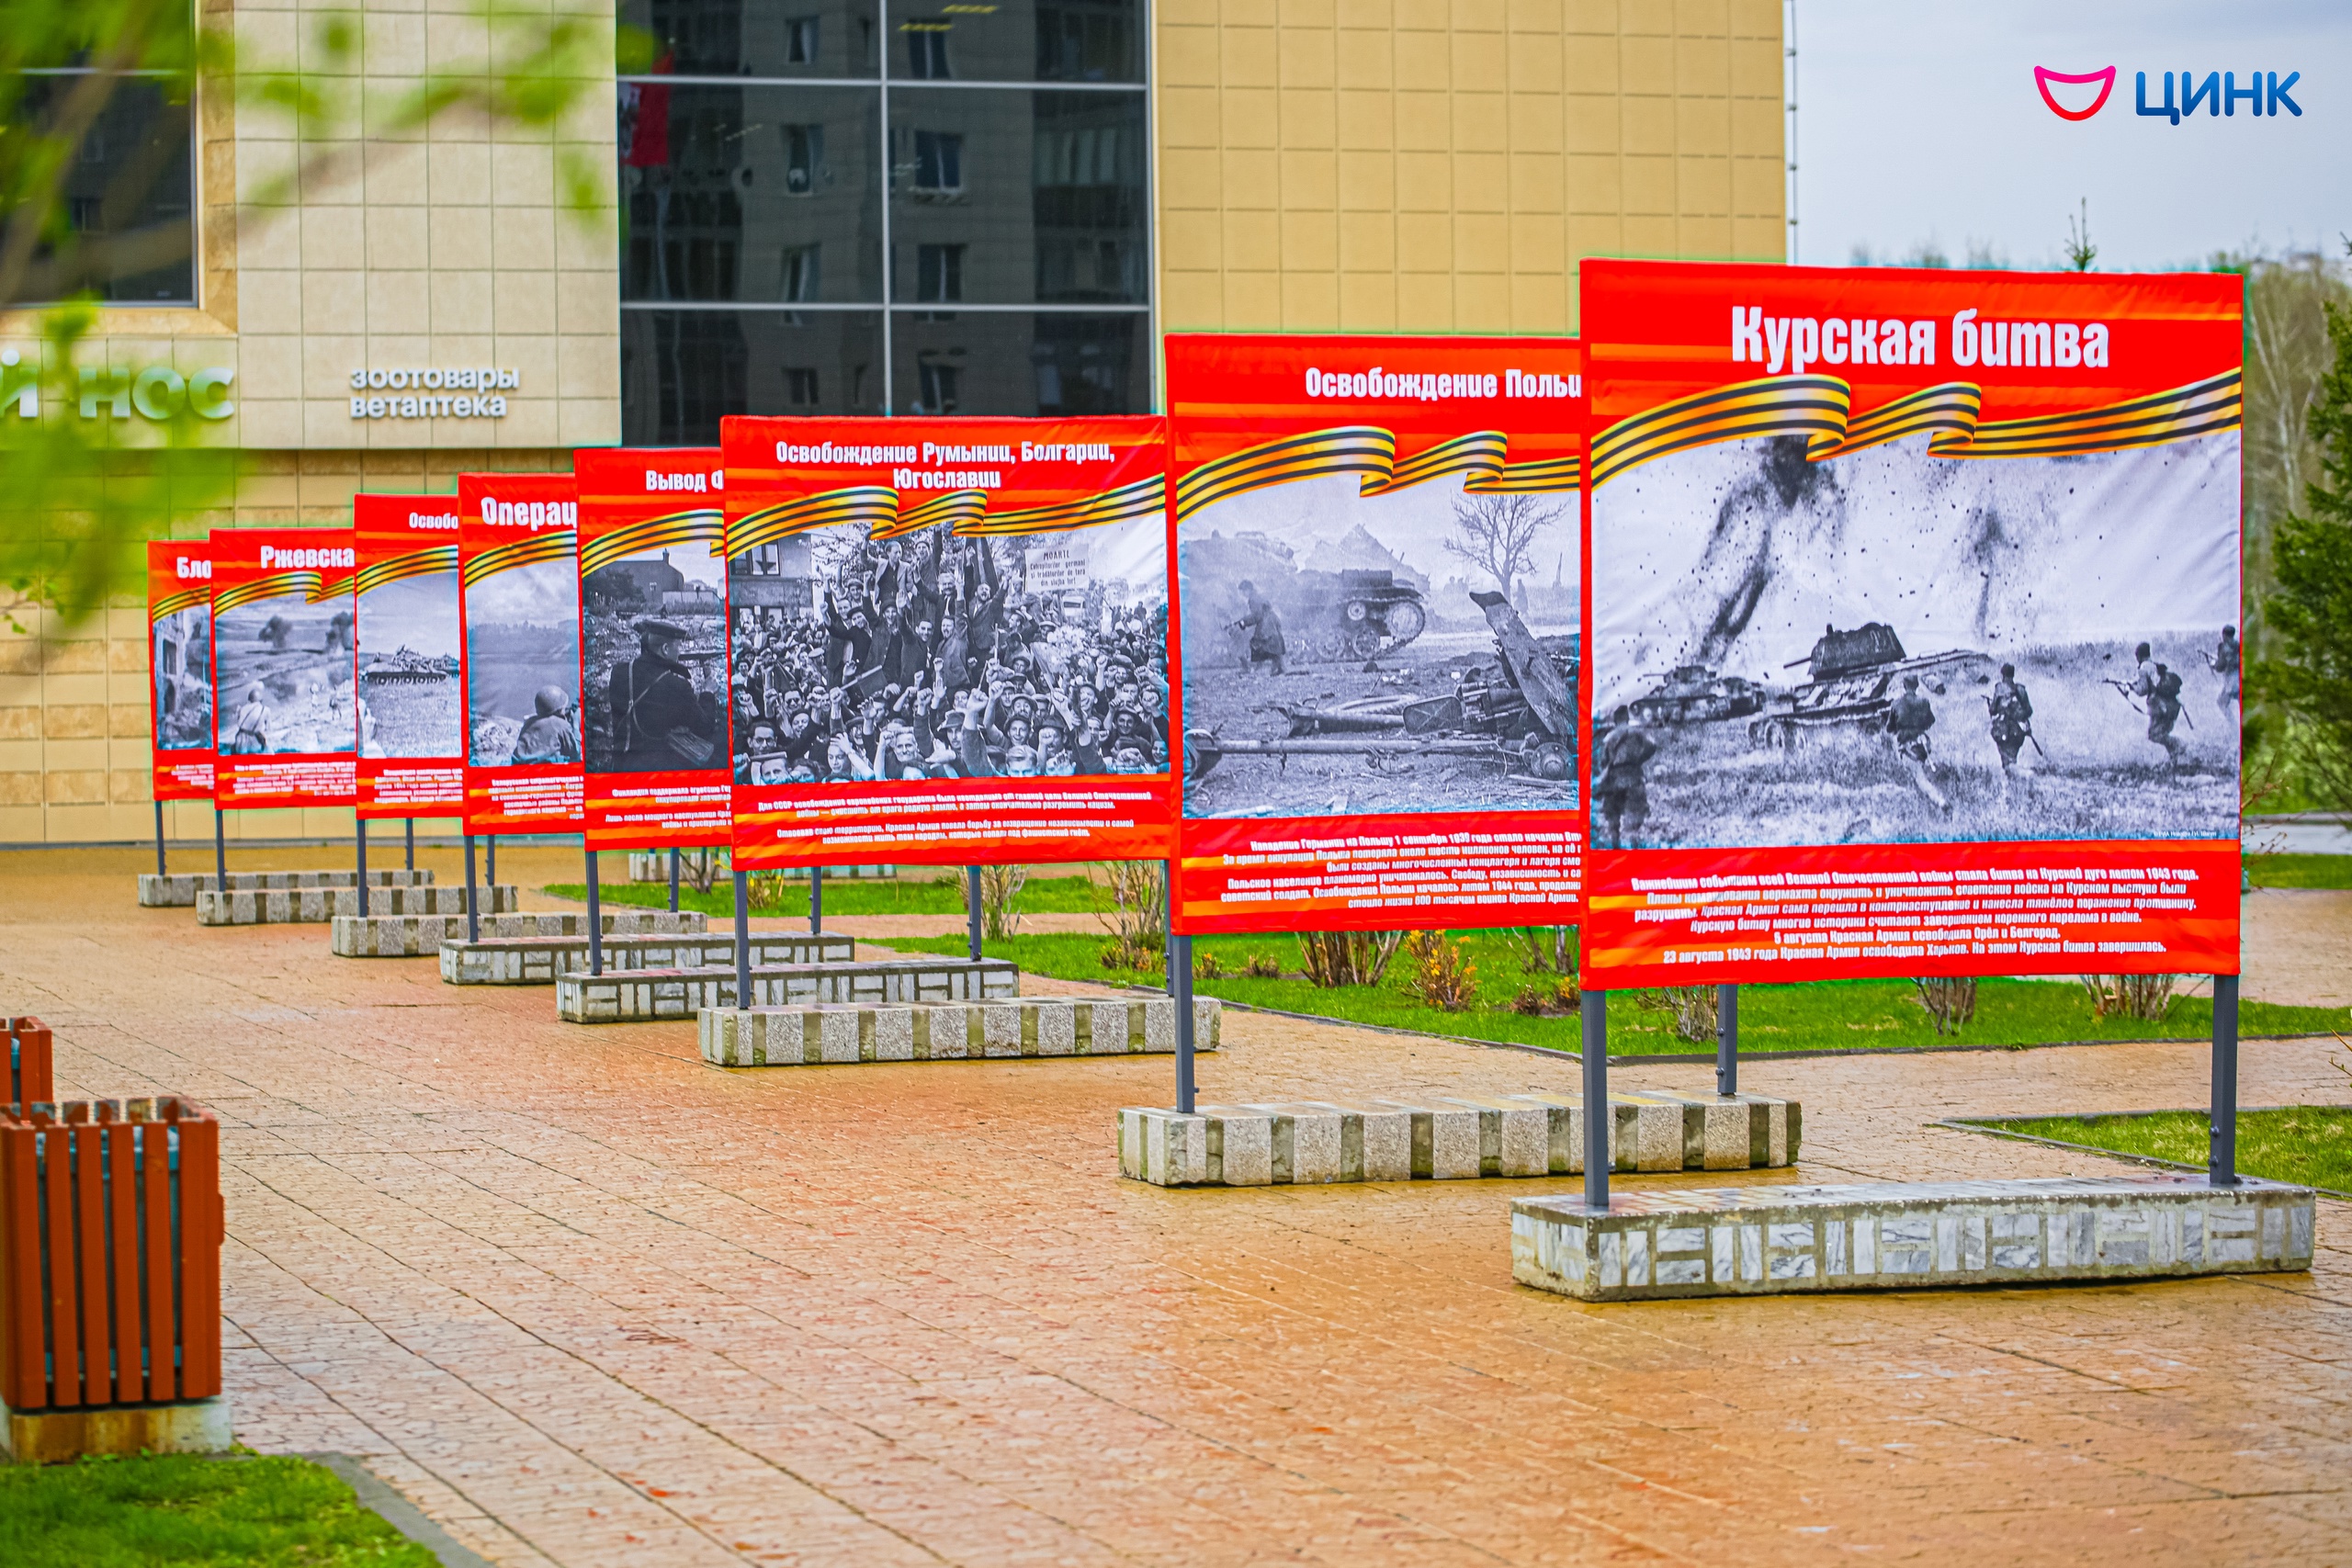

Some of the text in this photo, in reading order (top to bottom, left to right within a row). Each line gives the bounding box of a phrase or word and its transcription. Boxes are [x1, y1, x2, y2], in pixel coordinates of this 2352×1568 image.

[1732, 306, 2109, 374] Курская битва
[350, 367, 520, 392] зоотовары
[1306, 367, 1498, 401] Освобождение
[350, 395, 507, 418] ветаптека
[776, 441, 1115, 467] Освобождение Румынии, Болгарии,
[646, 470, 707, 492] Вывод
[894, 468, 1001, 489] Югославии
[481, 497, 577, 531] Операц
[261, 546, 356, 569] Ржевска
[1632, 878, 1698, 890] Важнейшим
[1758, 874, 1784, 885] всей
[1786, 873, 1830, 885] Великой
[1832, 872, 1918, 884] Отечественной
[1919, 871, 1953, 882] войны
[1955, 871, 1988, 880] стала
[1990, 868, 2024, 880] битва
[2026, 869, 2039, 879] на
[2040, 867, 2082, 881] Курской
[2085, 869, 2107, 881] дуге
[2109, 869, 2144, 879] летом
[2146, 868, 2170, 879] 1943
[2172, 869, 2198, 879] года.
[1647, 893, 1682, 905] Планы
[1763, 889, 1817, 900] вермахта
[1820, 888, 1873, 900] окружить
[1876, 888, 1883, 897] и
[1885, 886, 1953, 898] уничтожить
[1956, 885, 2011, 895] советские
[2014, 884, 2049, 895] войска
[2052, 884, 2064, 894] на
[2066, 883, 2109, 895] Курском
[2112, 884, 2157, 895] выступе
[2160, 879, 2186, 894] были
[1634, 907, 1698, 922] разрушены.
[1746, 904, 1780, 916] Армия
[1782, 904, 1809, 913] сама
[1812, 903, 1857, 913] перешла
[1860, 903, 1866, 911] в
[1870, 900, 1970, 912] контрнаступление
[1973, 900, 1979, 909] и
[1982, 899, 2023, 908] нанесла
[2026, 898, 2074, 908] тяжёлое
[2077, 898, 2131, 908] поражение
[2134, 898, 2196, 908] противнику.
[1690, 912, 2142, 932] Курскую битву многие историки считают завершением коренного перелома в войне.
[1783, 932, 1828, 944] августа
[1830, 931, 1873, 943] Красная
[1876, 930, 1910, 942] Армия
[1974, 927, 1998, 941] Орёл
[2001, 929, 2007, 938] и
[2010, 927, 2061, 939] Белгород.
[1679, 951, 1724, 963] августа
[1754, 949, 1778, 960] года
[1781, 947, 1824, 960] Красная
[1826, 946, 1860, 959] Армия
[1862, 945, 1924, 957] освободила
[1988, 943, 2017, 953] этом
[2019, 942, 2061, 954] Курская
[2064, 941, 2095, 953] битва
[2098, 942, 2166, 953] завершилась.
